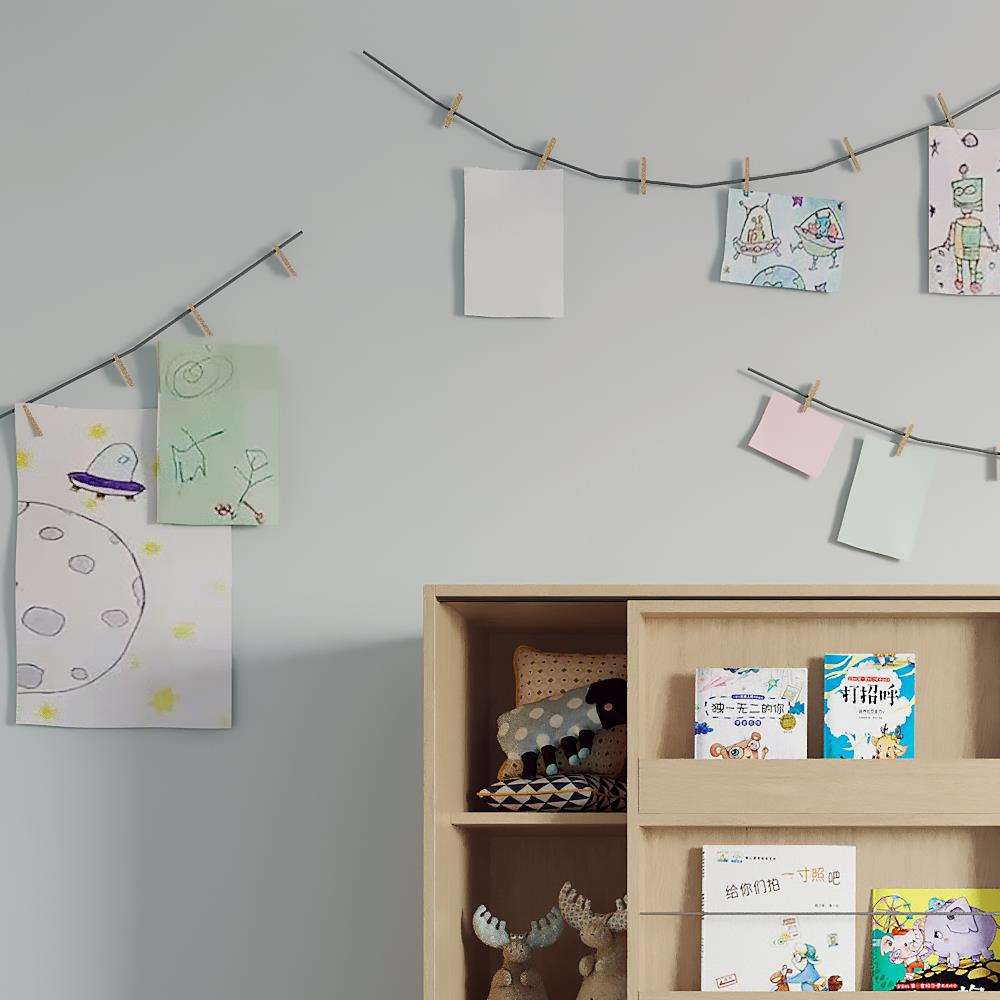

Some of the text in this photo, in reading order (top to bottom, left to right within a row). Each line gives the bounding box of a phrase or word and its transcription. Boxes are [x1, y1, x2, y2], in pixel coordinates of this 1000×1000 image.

[841, 684, 898, 706] 打招呼
[711, 702, 784, 714] 独一无二的你
[725, 866, 841, 899] 给你们拍一寸照吧
